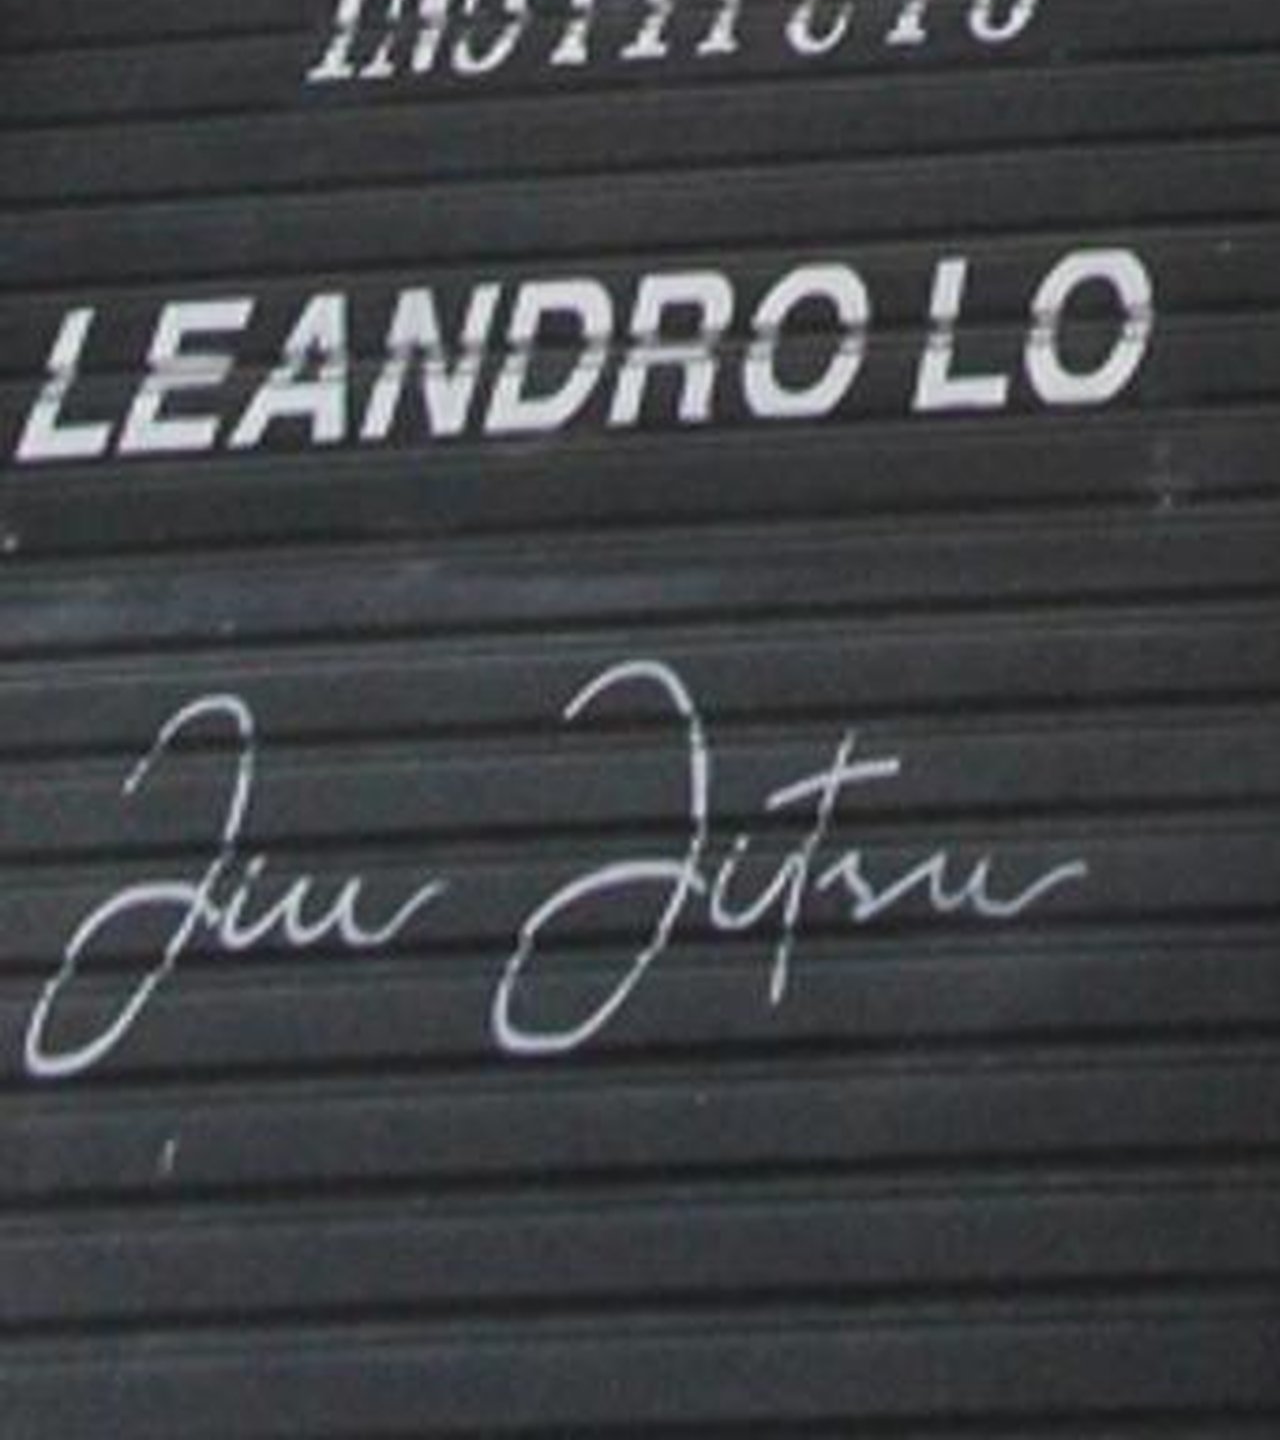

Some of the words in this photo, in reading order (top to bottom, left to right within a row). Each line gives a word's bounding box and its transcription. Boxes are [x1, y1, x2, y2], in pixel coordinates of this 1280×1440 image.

[15, 261, 869, 463] LEANDRO
[912, 247, 1154, 413] LO
[23, 693, 441, 1076] Jiu
[490, 660, 1088, 1054] Jitsu
